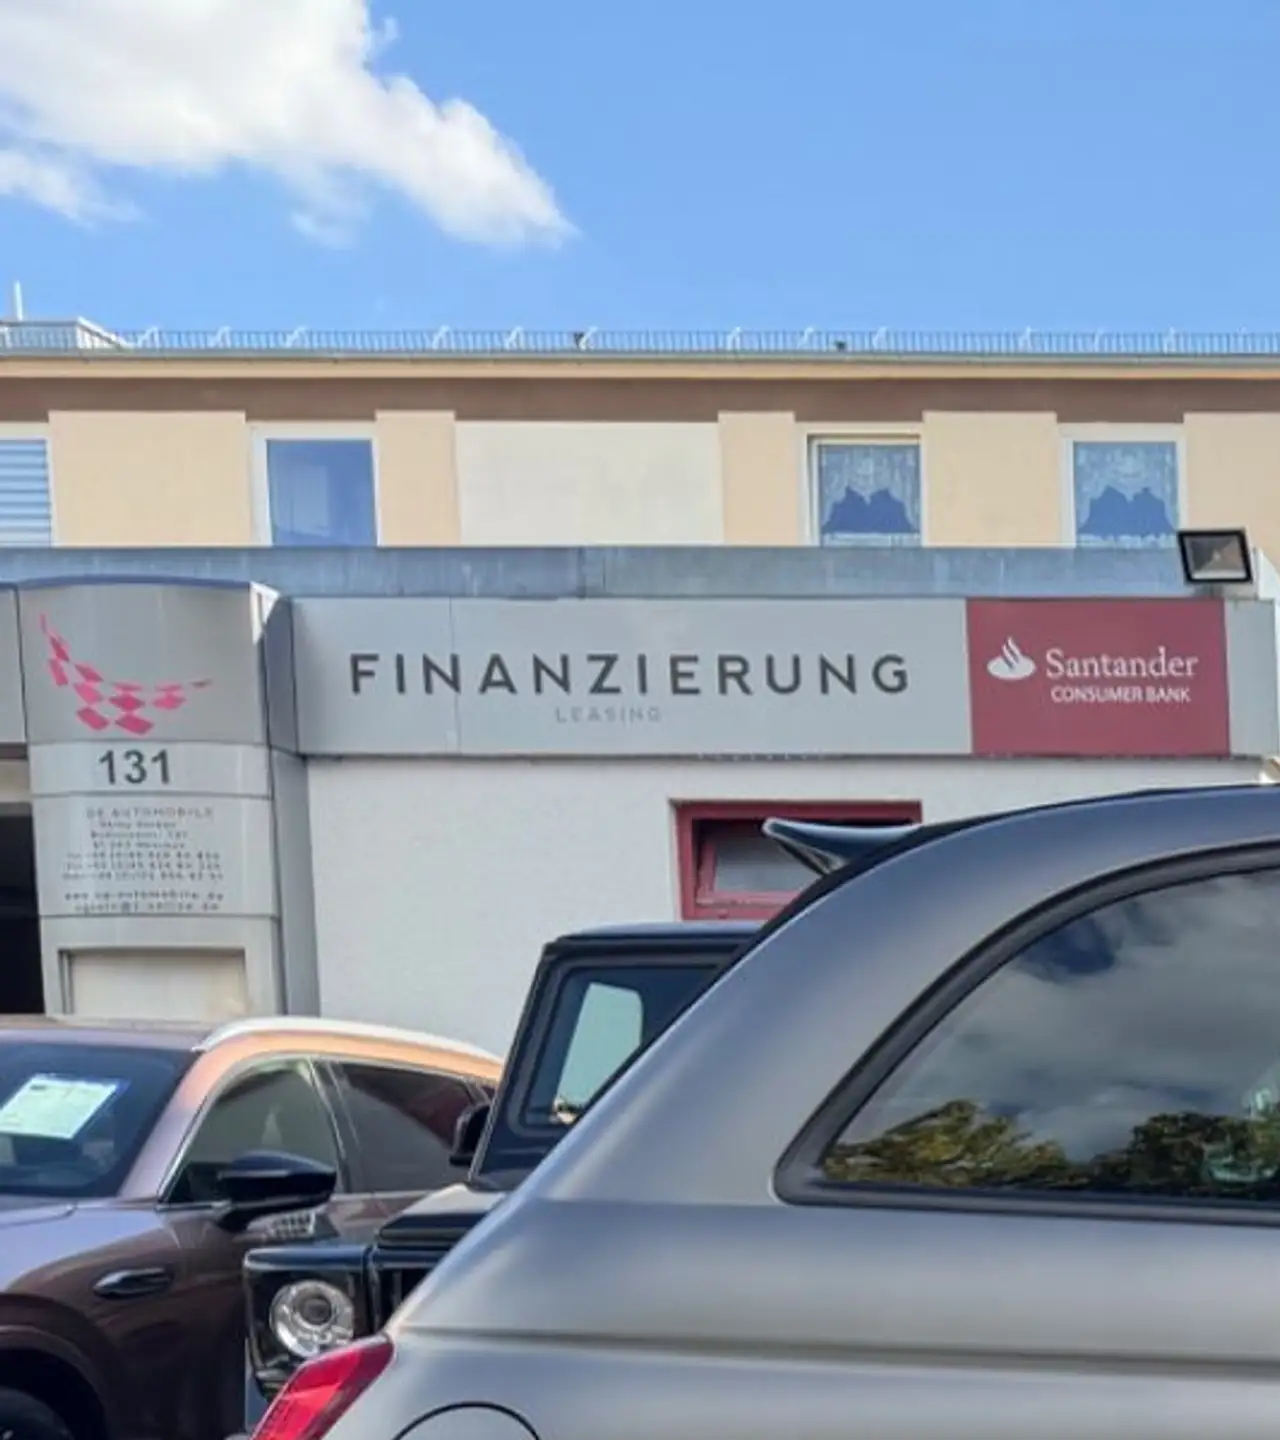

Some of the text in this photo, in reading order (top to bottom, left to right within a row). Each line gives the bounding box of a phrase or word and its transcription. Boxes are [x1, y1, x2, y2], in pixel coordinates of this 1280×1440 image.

[350, 653, 908, 696] FINANZIERUNG
[1045, 645, 1199, 679] Santander
[1051, 685, 1191, 703] CONSUMER BANK
[555, 706, 661, 723] LEASING
[98, 749, 170, 785] 131
